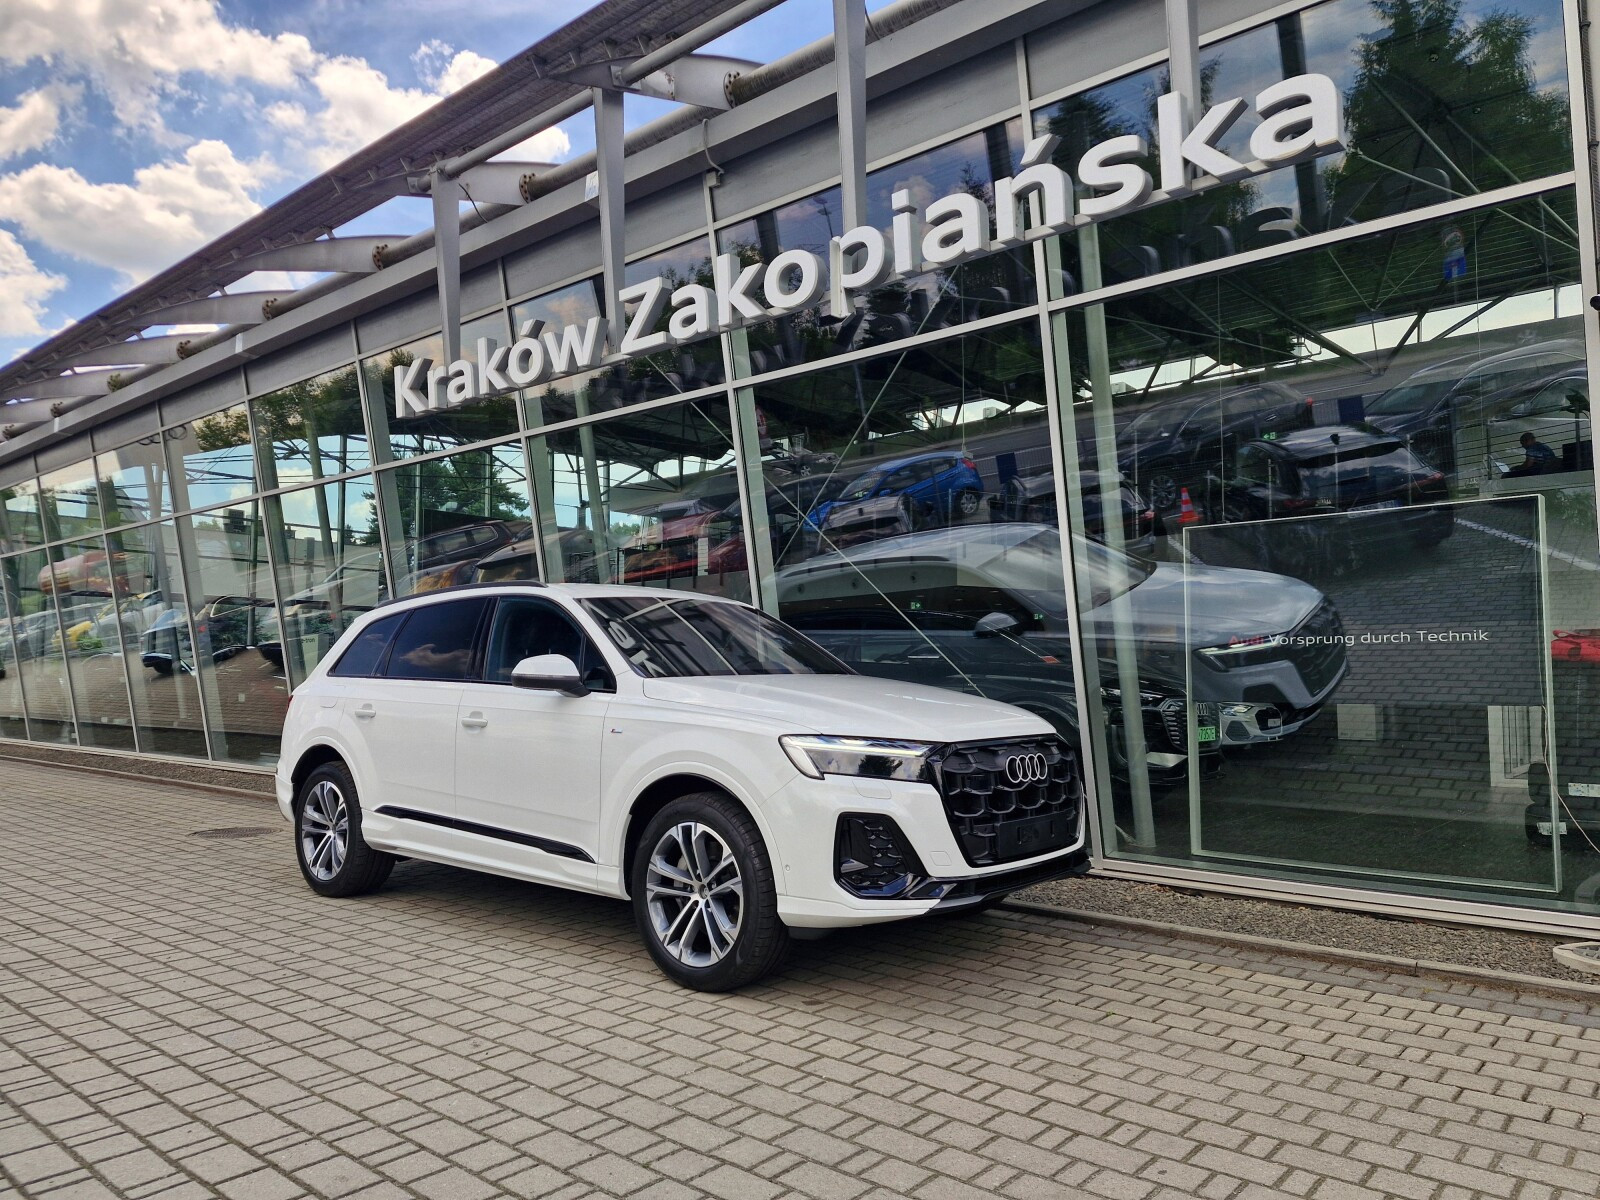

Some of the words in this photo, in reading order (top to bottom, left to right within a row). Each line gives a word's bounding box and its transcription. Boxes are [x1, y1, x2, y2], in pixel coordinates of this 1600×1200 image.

[393, 316, 606, 419] Kraków
[618, 74, 1343, 355] Zakopiańska
[1268, 634, 1355, 647] Vorsprung
[1360, 631, 1411, 643] durch
[1416, 629, 1489, 642] Technik
